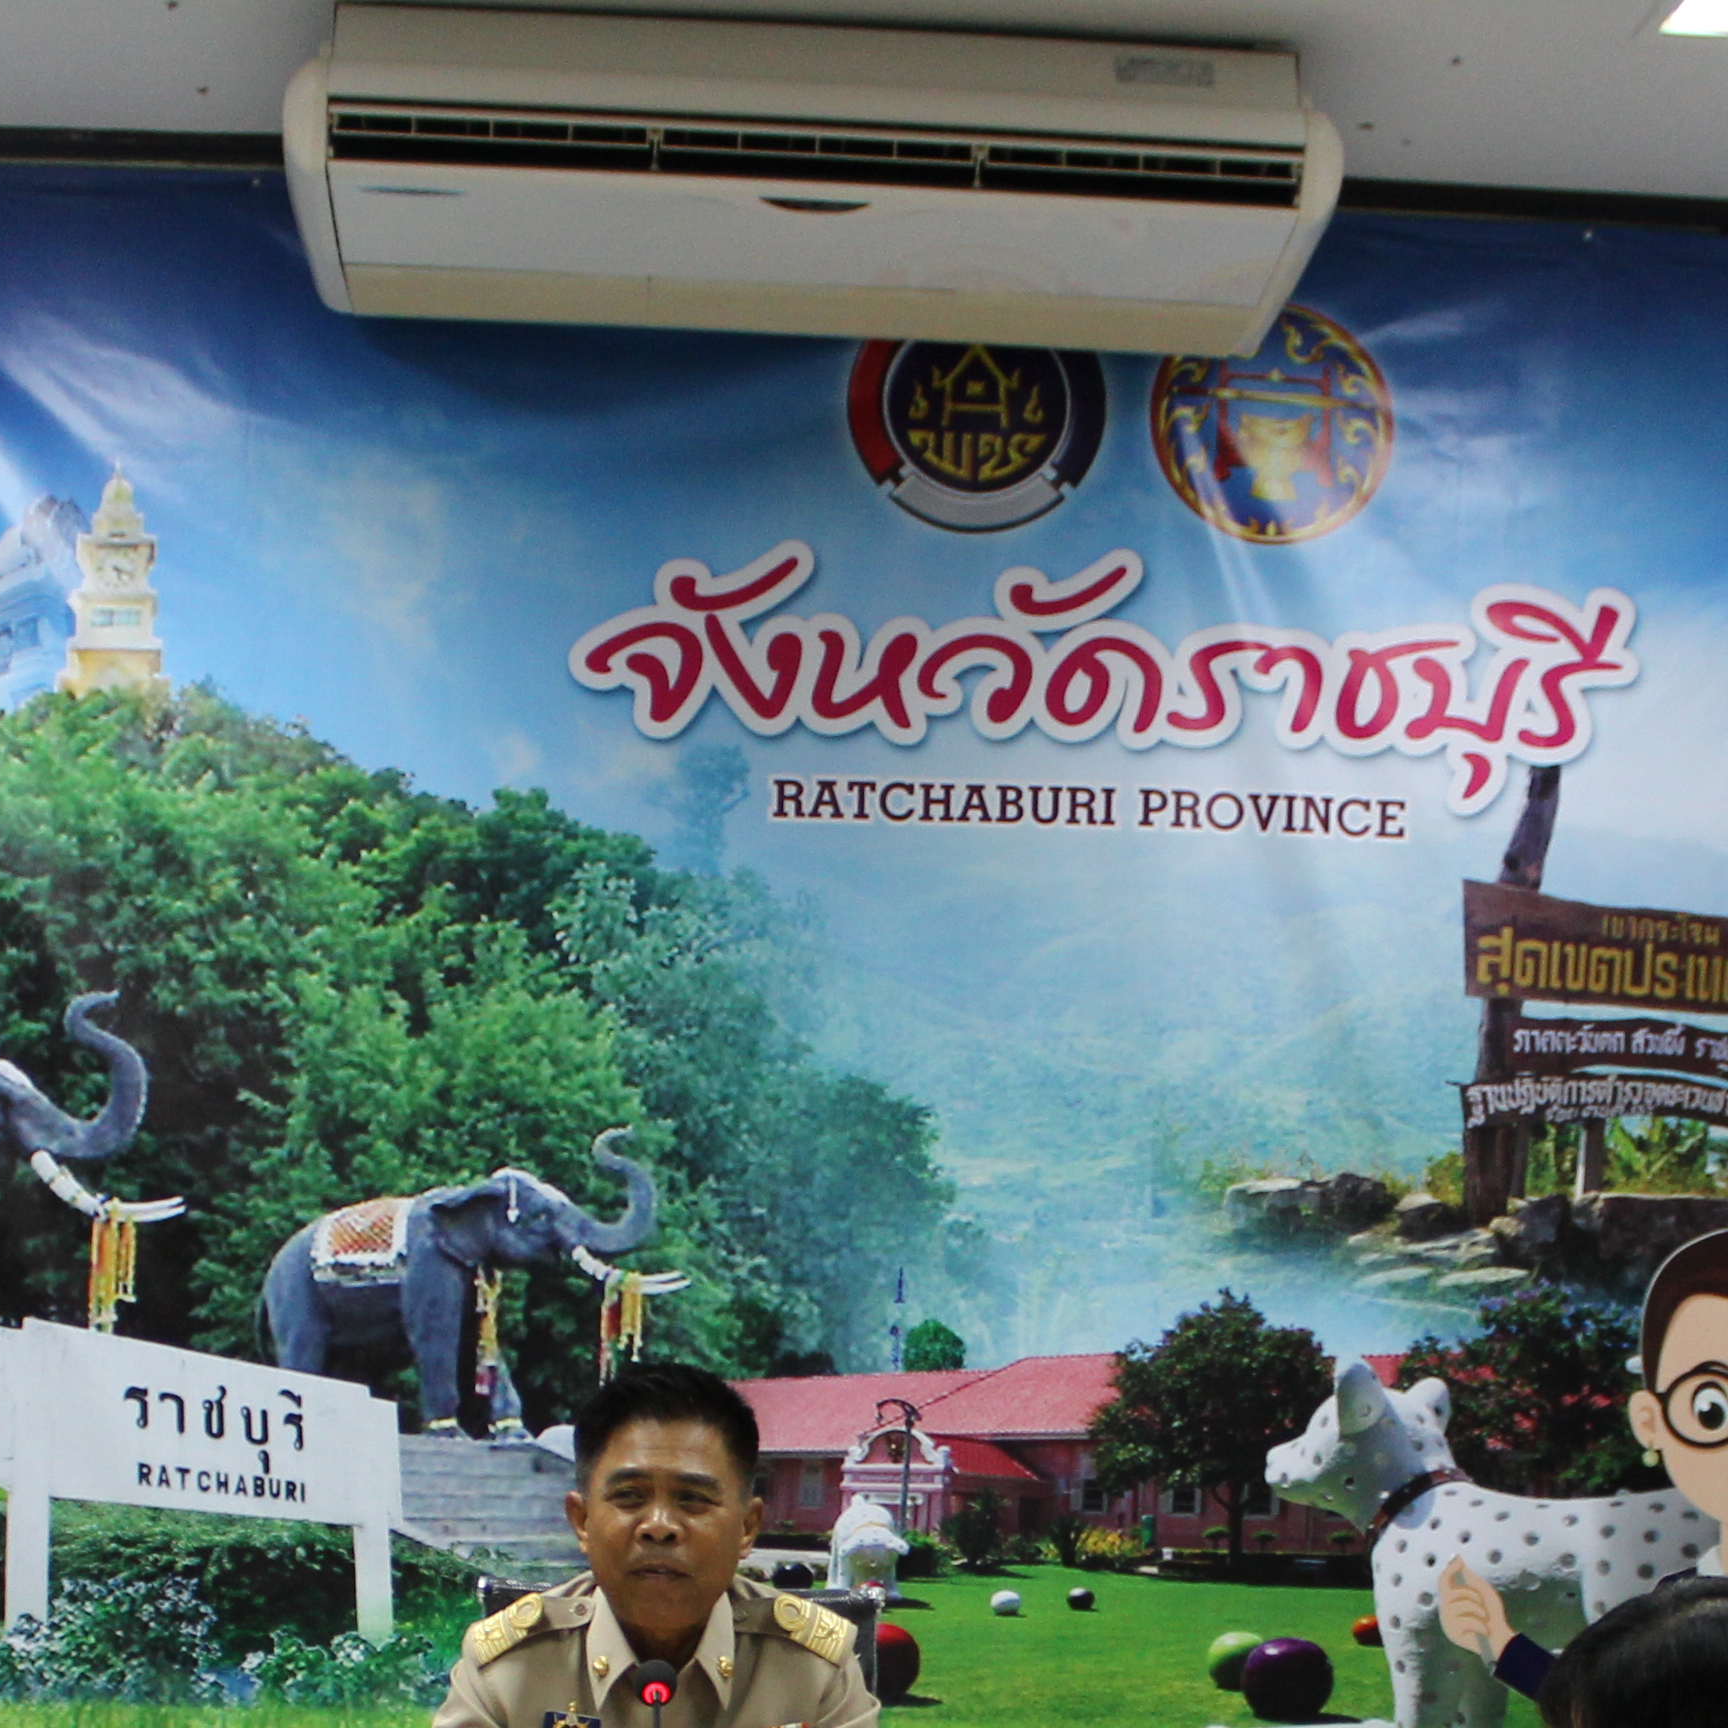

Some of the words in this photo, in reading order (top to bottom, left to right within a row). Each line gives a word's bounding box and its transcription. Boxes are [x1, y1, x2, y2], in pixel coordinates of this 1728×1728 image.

[584, 554, 1624, 800] จังหวัดราชบุรี
[771, 781, 1118, 826] RATCHABURI
[1138, 788, 1407, 839] PROVINCE
[124, 1384, 303, 1474] ราชบุรี
[137, 1463, 305, 1502] RATCHABURI
